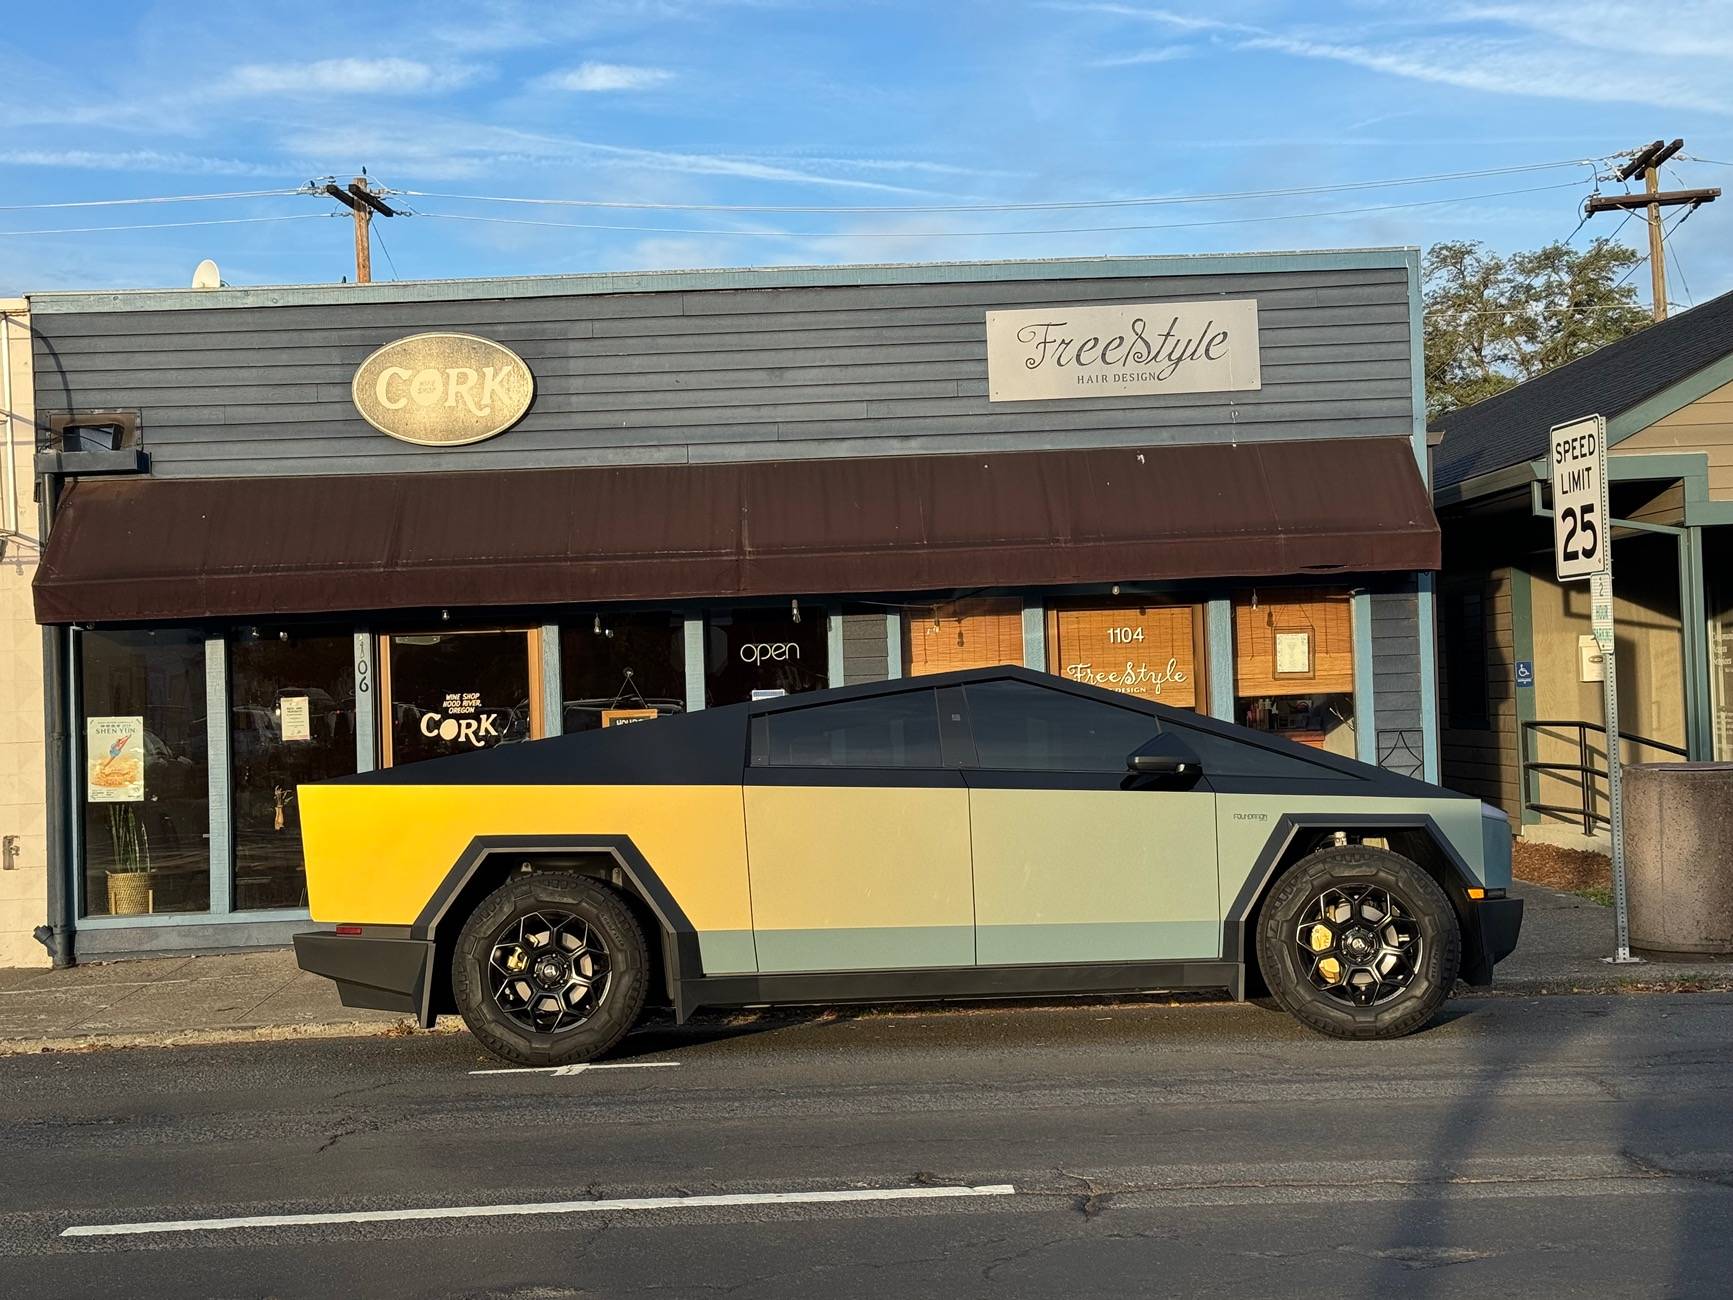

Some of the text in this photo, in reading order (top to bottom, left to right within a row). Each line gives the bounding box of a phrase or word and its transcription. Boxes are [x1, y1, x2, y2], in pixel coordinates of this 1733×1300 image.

[1017, 317, 1229, 381] FreeStyle
[376, 366, 513, 417] CORK
[1077, 372, 1157, 385] HAIR DESIGN
[1555, 433, 1596, 464] SPEED
[1561, 466, 1592, 495] LIMIT
[1561, 503, 1598, 562] 25
[1107, 627, 1145, 643] 1104
[740, 643, 800, 666] open
[1067, 658, 1187, 694] FreeStyle
[420, 712, 498, 747] CORK
